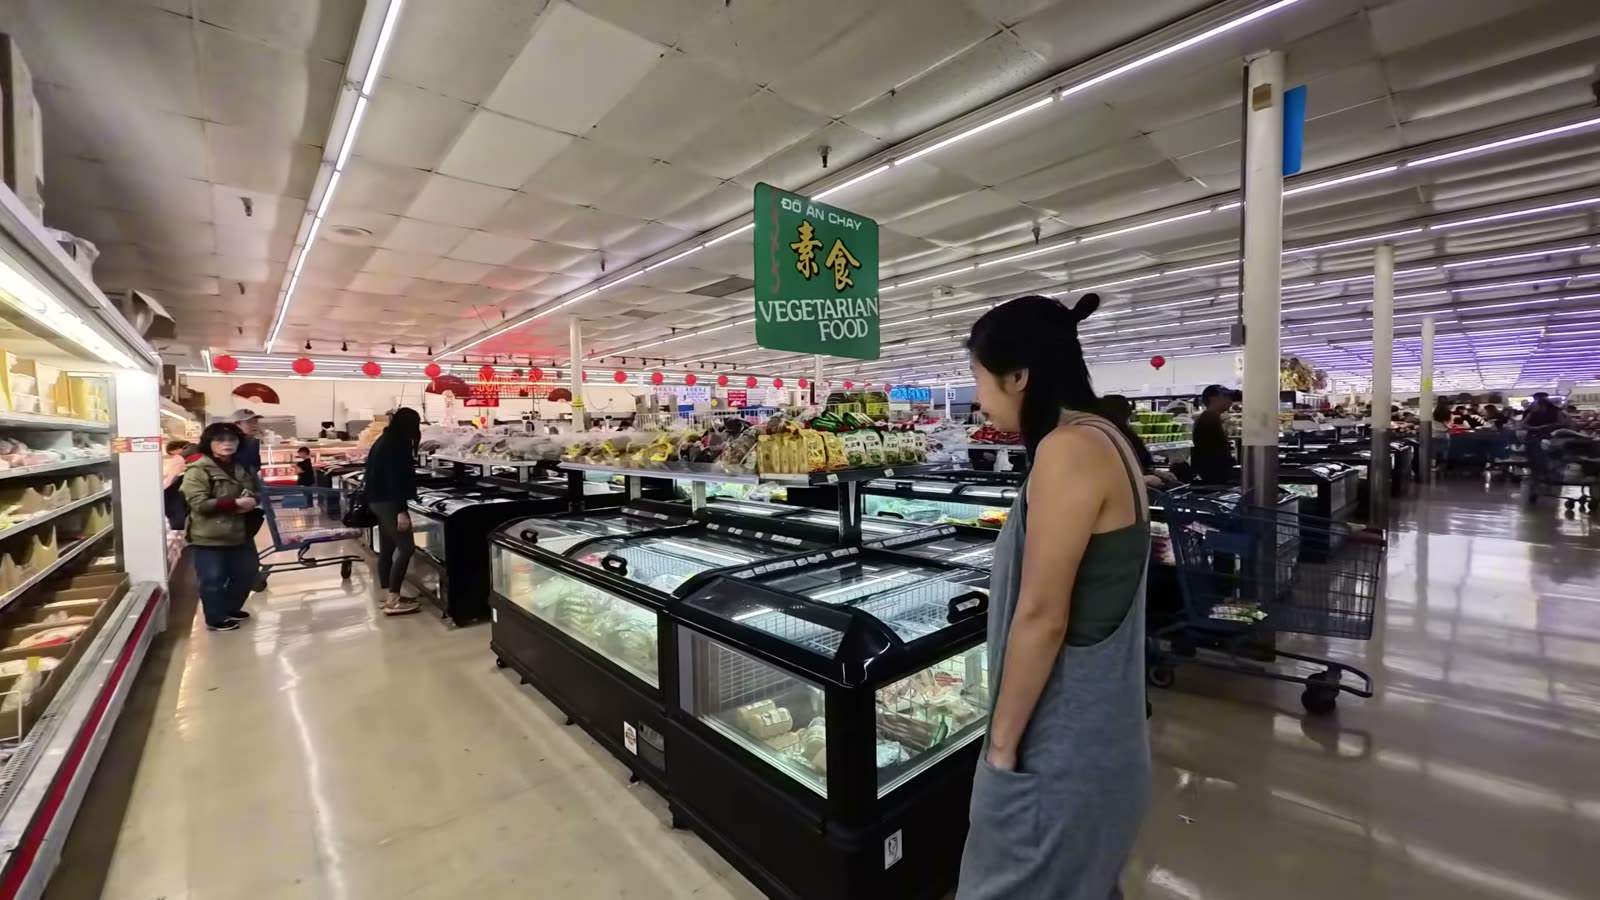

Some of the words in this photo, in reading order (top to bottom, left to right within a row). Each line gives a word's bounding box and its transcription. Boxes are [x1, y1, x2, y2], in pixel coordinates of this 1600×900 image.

[828, 212, 862, 231] CHAY
[790, 220, 861, 292] 素食
[758, 297, 878, 322] VEGETARIAN
[819, 318, 868, 341] FOOD
